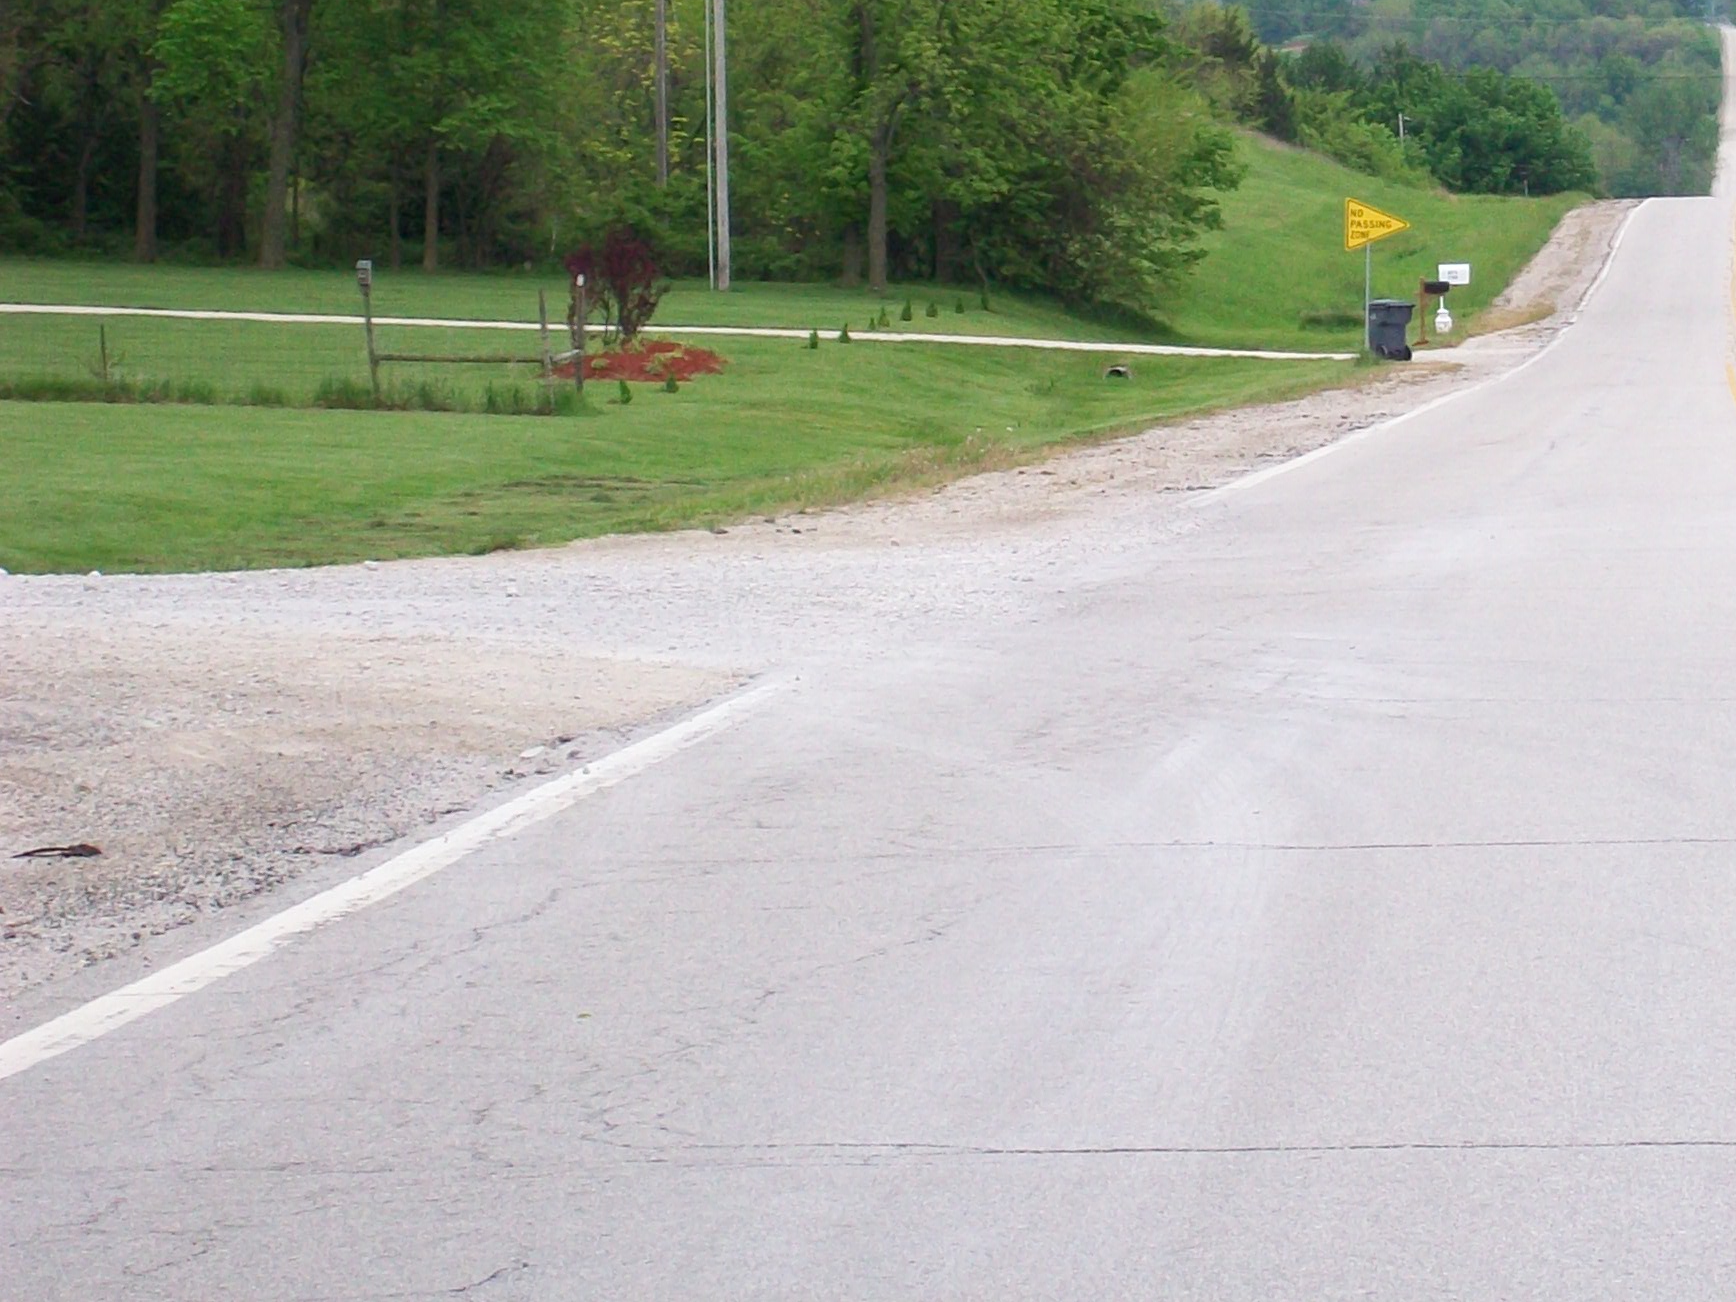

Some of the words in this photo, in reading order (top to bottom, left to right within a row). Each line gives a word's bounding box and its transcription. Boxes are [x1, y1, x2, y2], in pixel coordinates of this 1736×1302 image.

[1350, 209, 1364, 218] NO
[1350, 219, 1392, 229] PASSING
[1350, 230, 1370, 240] ZONE
